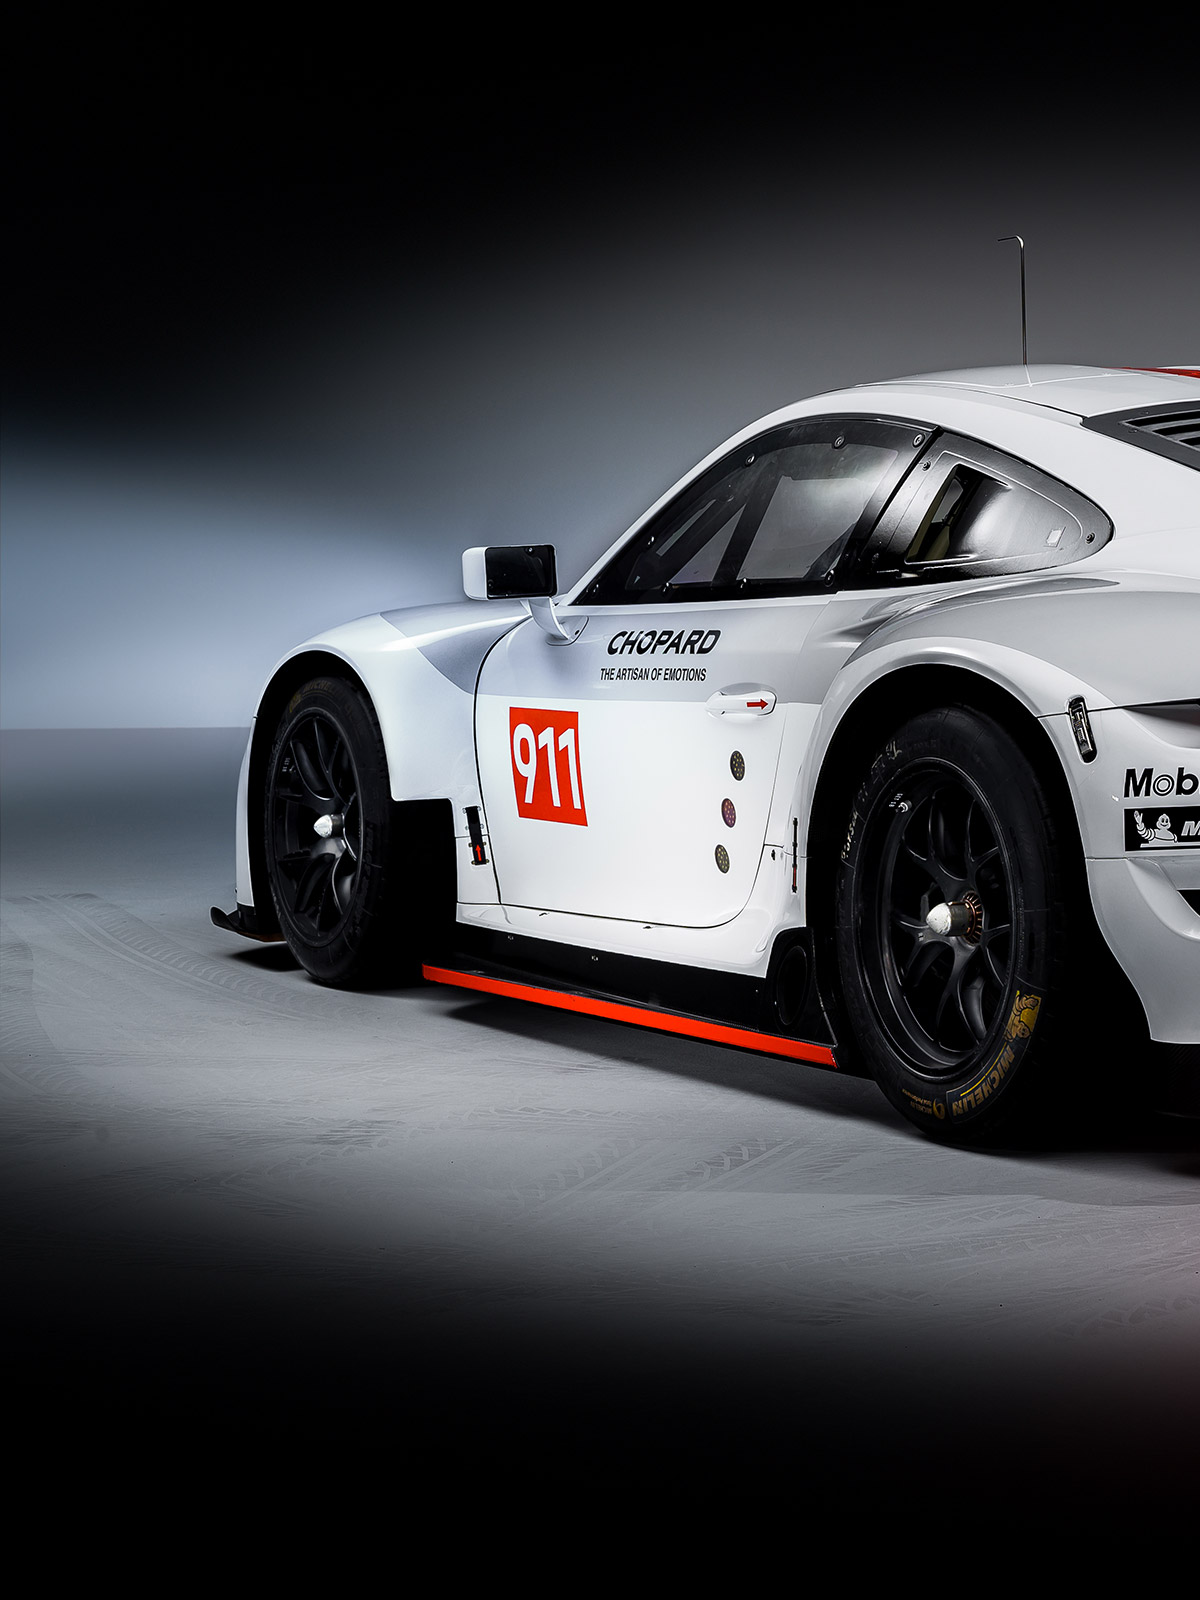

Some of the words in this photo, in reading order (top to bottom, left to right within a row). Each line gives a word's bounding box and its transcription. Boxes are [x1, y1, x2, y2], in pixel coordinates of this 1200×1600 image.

[607, 629, 721, 656] CHOPARD
[600, 667, 615, 681] THE
[615, 667, 650, 681] ARTISAN
[650, 667, 662, 681] OF
[663, 667, 707, 681] EMOTIONS
[513, 723, 582, 810] 911
[952, 1046, 1015, 1117] MICHELIN
